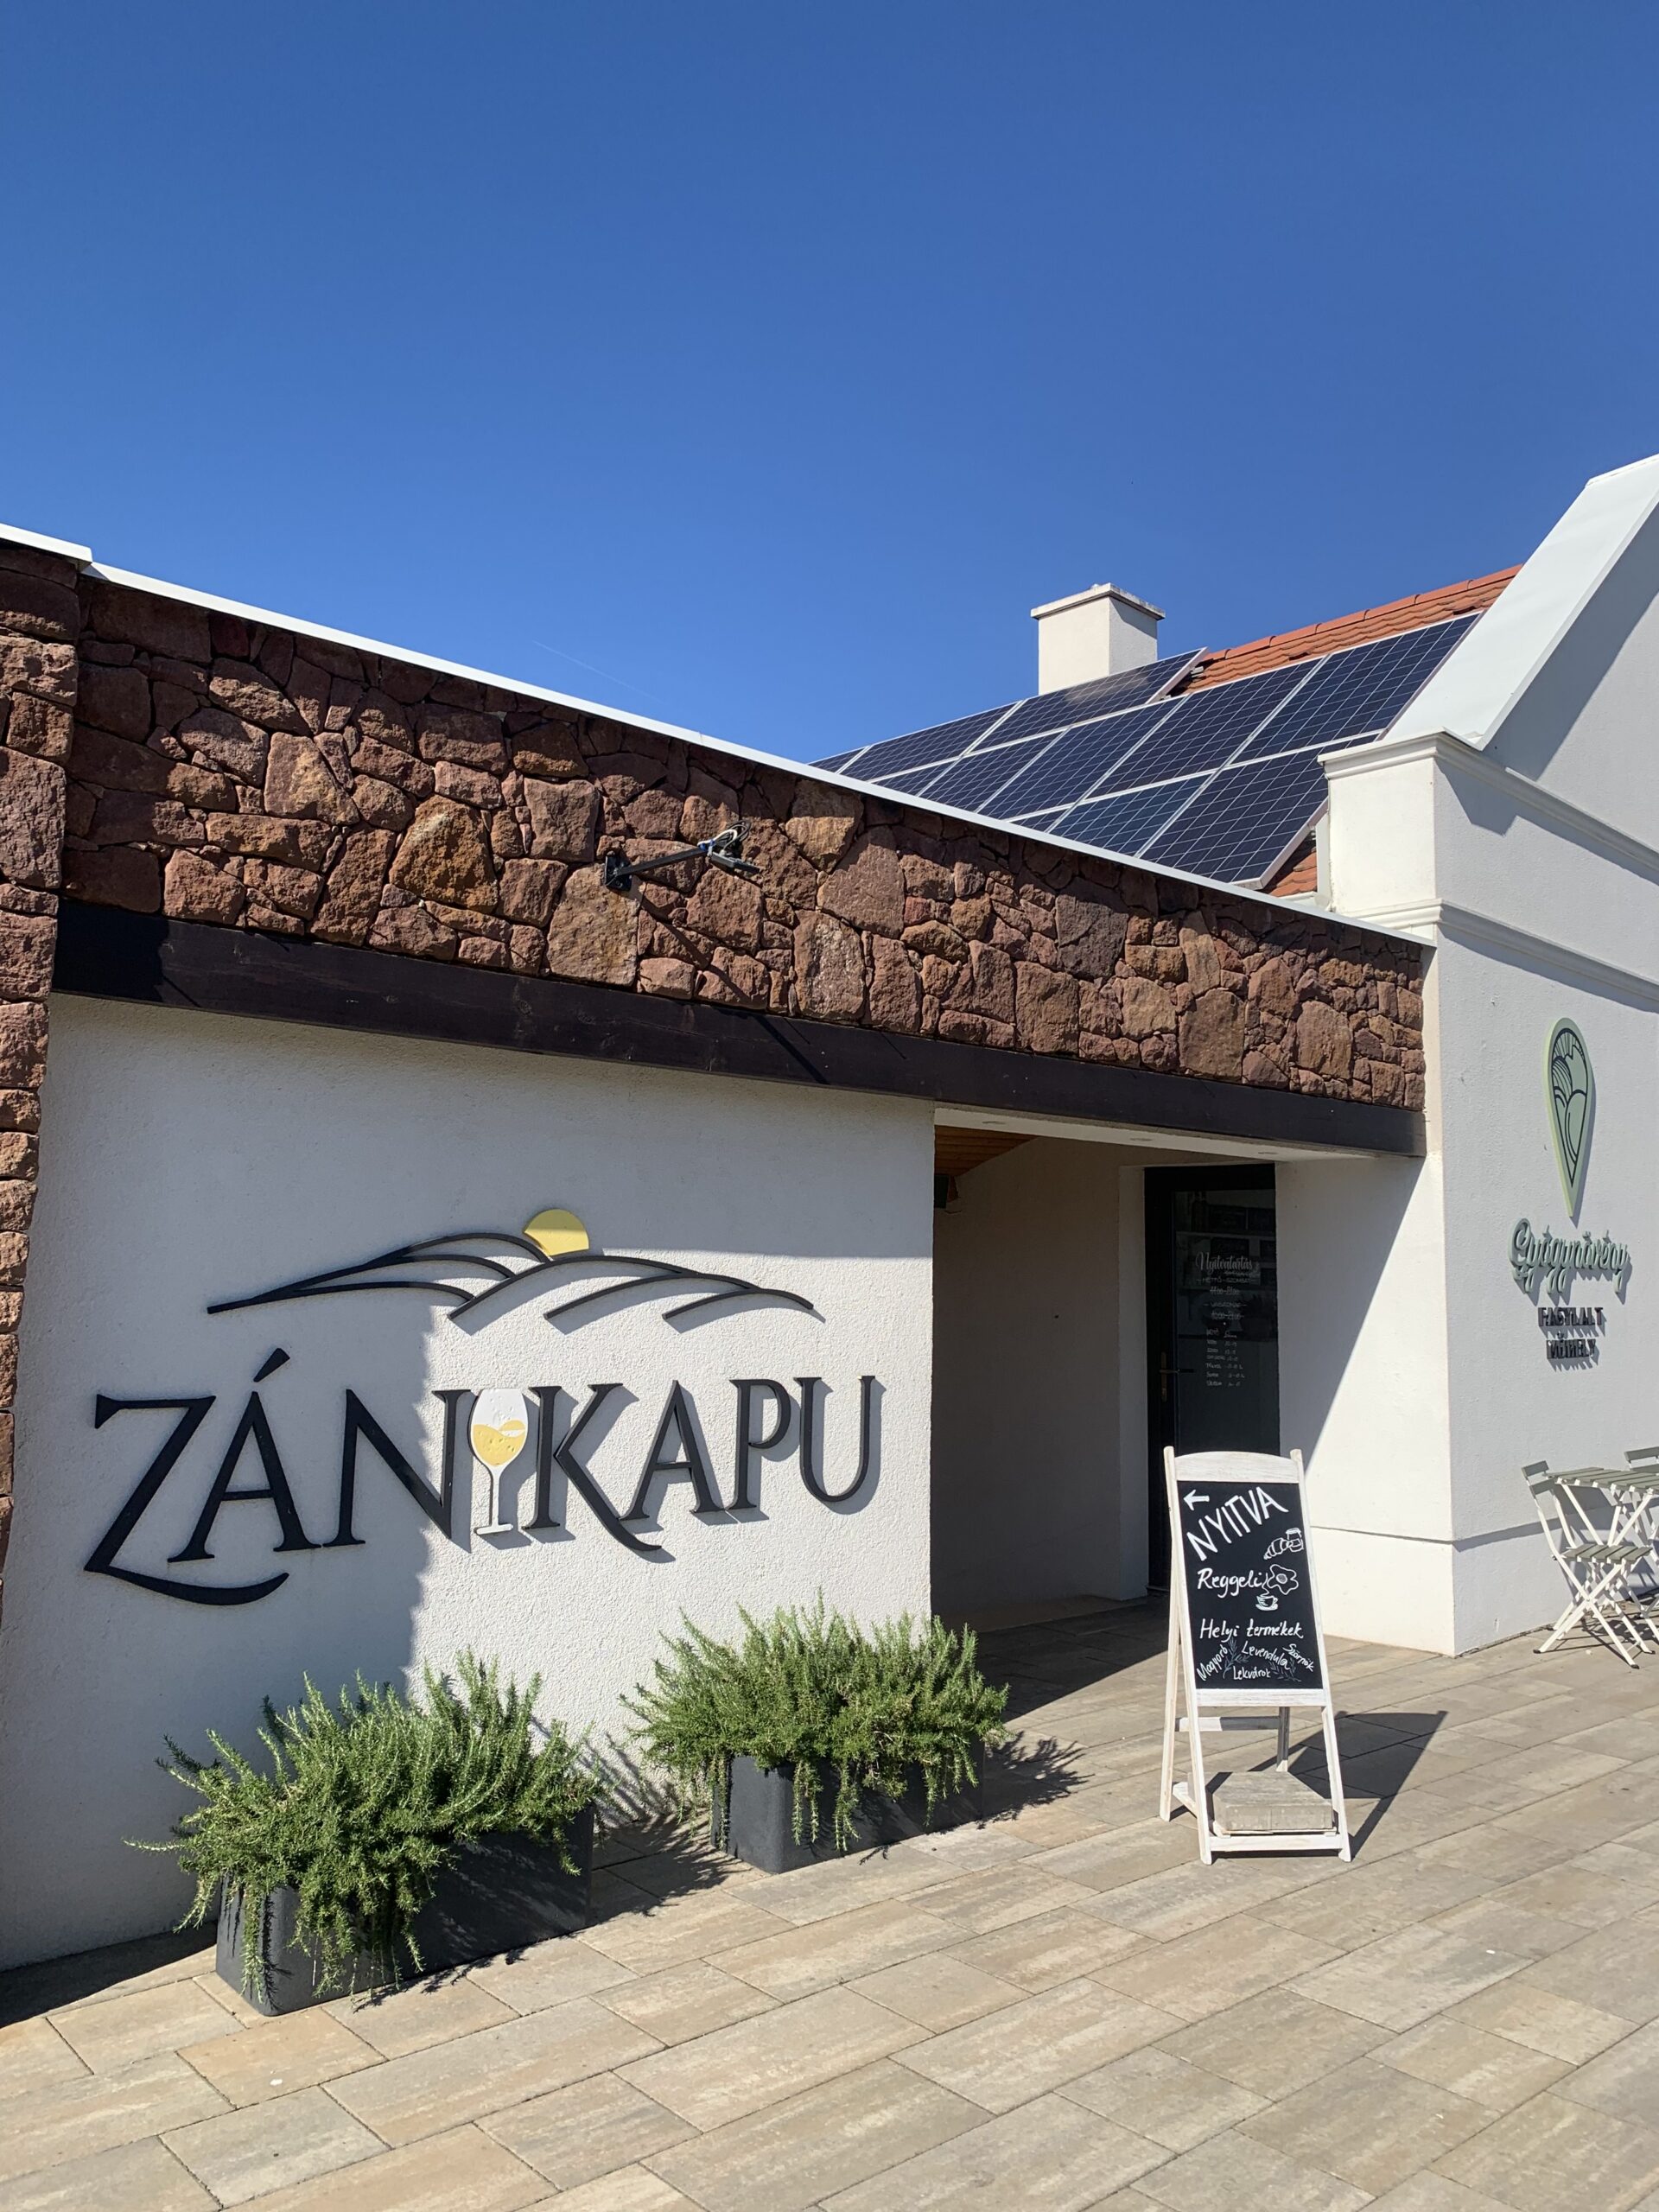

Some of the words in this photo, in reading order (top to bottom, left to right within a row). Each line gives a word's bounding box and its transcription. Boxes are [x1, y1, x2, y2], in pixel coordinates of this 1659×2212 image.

[1538, 1307, 1604, 1327] FAGYLALT
[1186, 1486, 1289, 1561] NYITVA
[1197, 1567, 1262, 1599] Reggeli
[1199, 1618, 1239, 1643] Helyi
[1246, 1618, 1304, 1639] termékek
[1241, 1640, 1291, 1670] Levendula
[1232, 1665, 1271, 1681] Lekvárok
